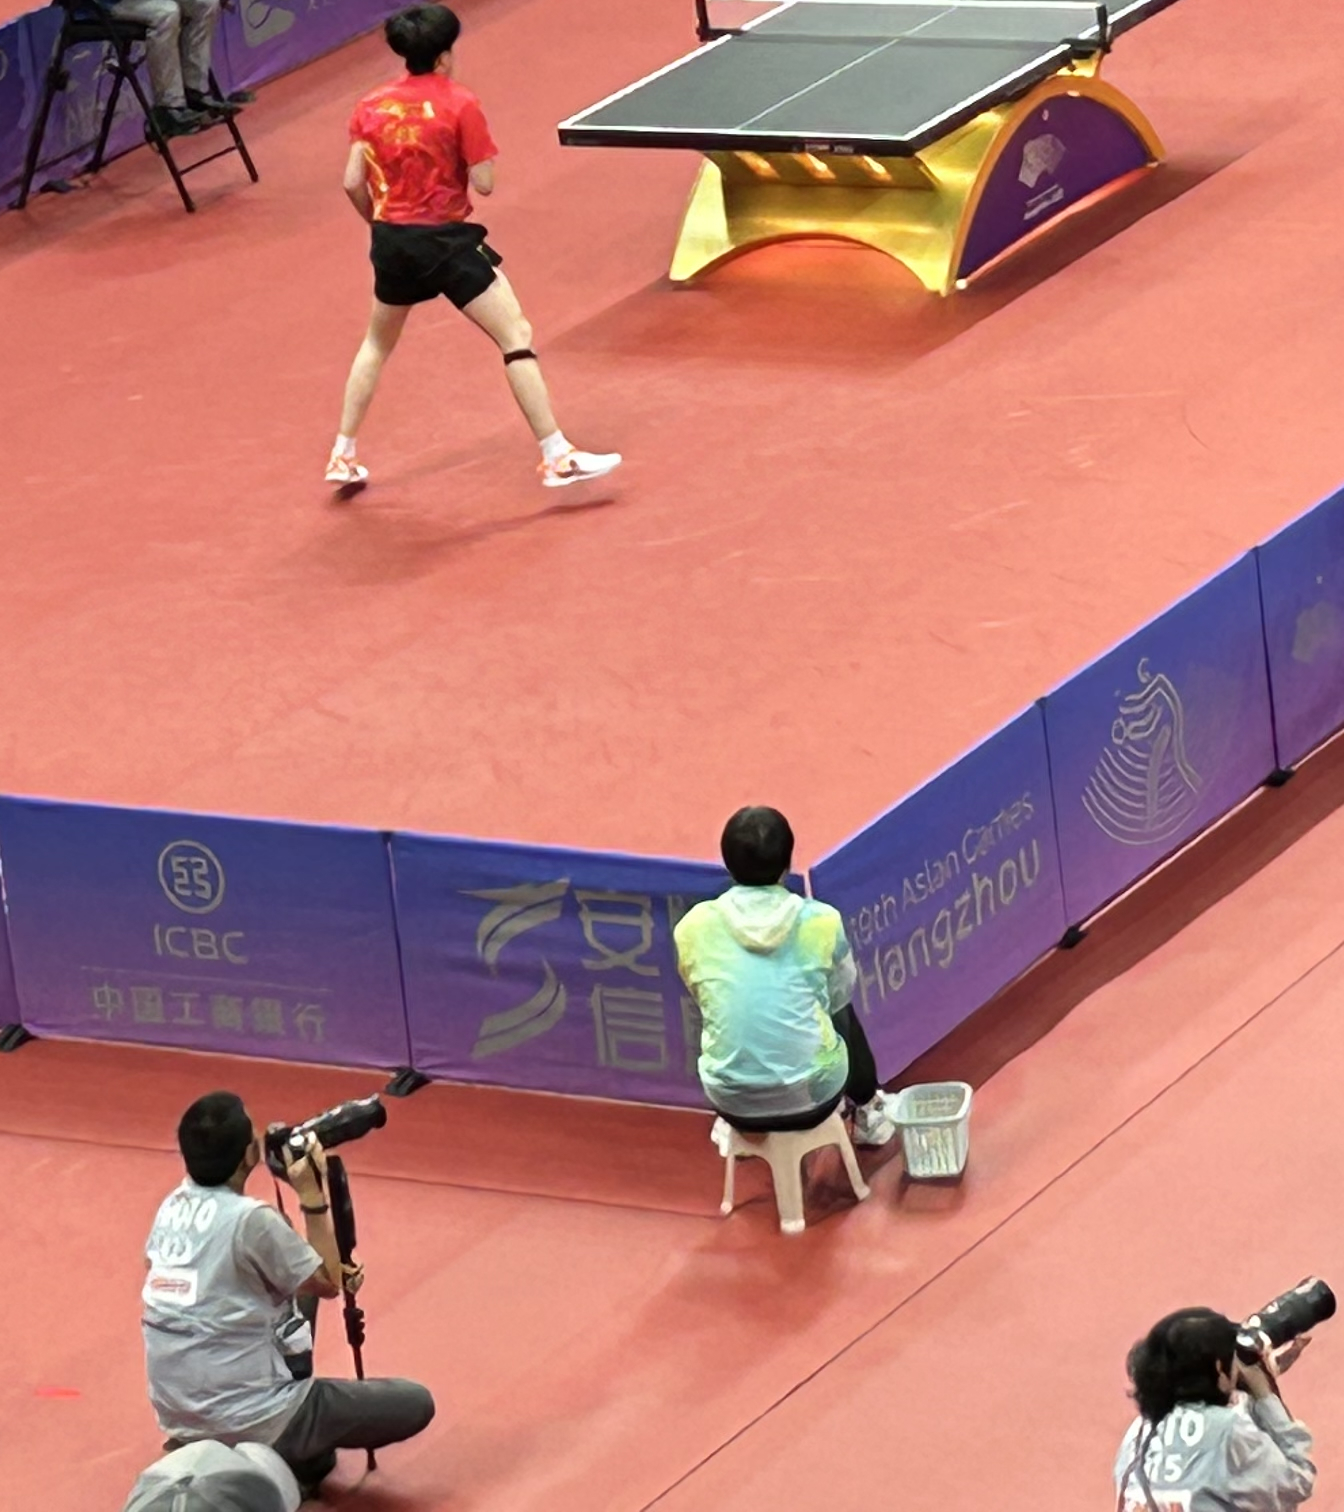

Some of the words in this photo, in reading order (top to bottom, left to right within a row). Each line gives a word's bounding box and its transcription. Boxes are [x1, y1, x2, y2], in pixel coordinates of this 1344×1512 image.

[902, 849, 959, 906] Asian
[962, 791, 1035, 864] Games
[154, 923, 249, 965] ICBC
[855, 839, 1040, 1015] Hangzhou
